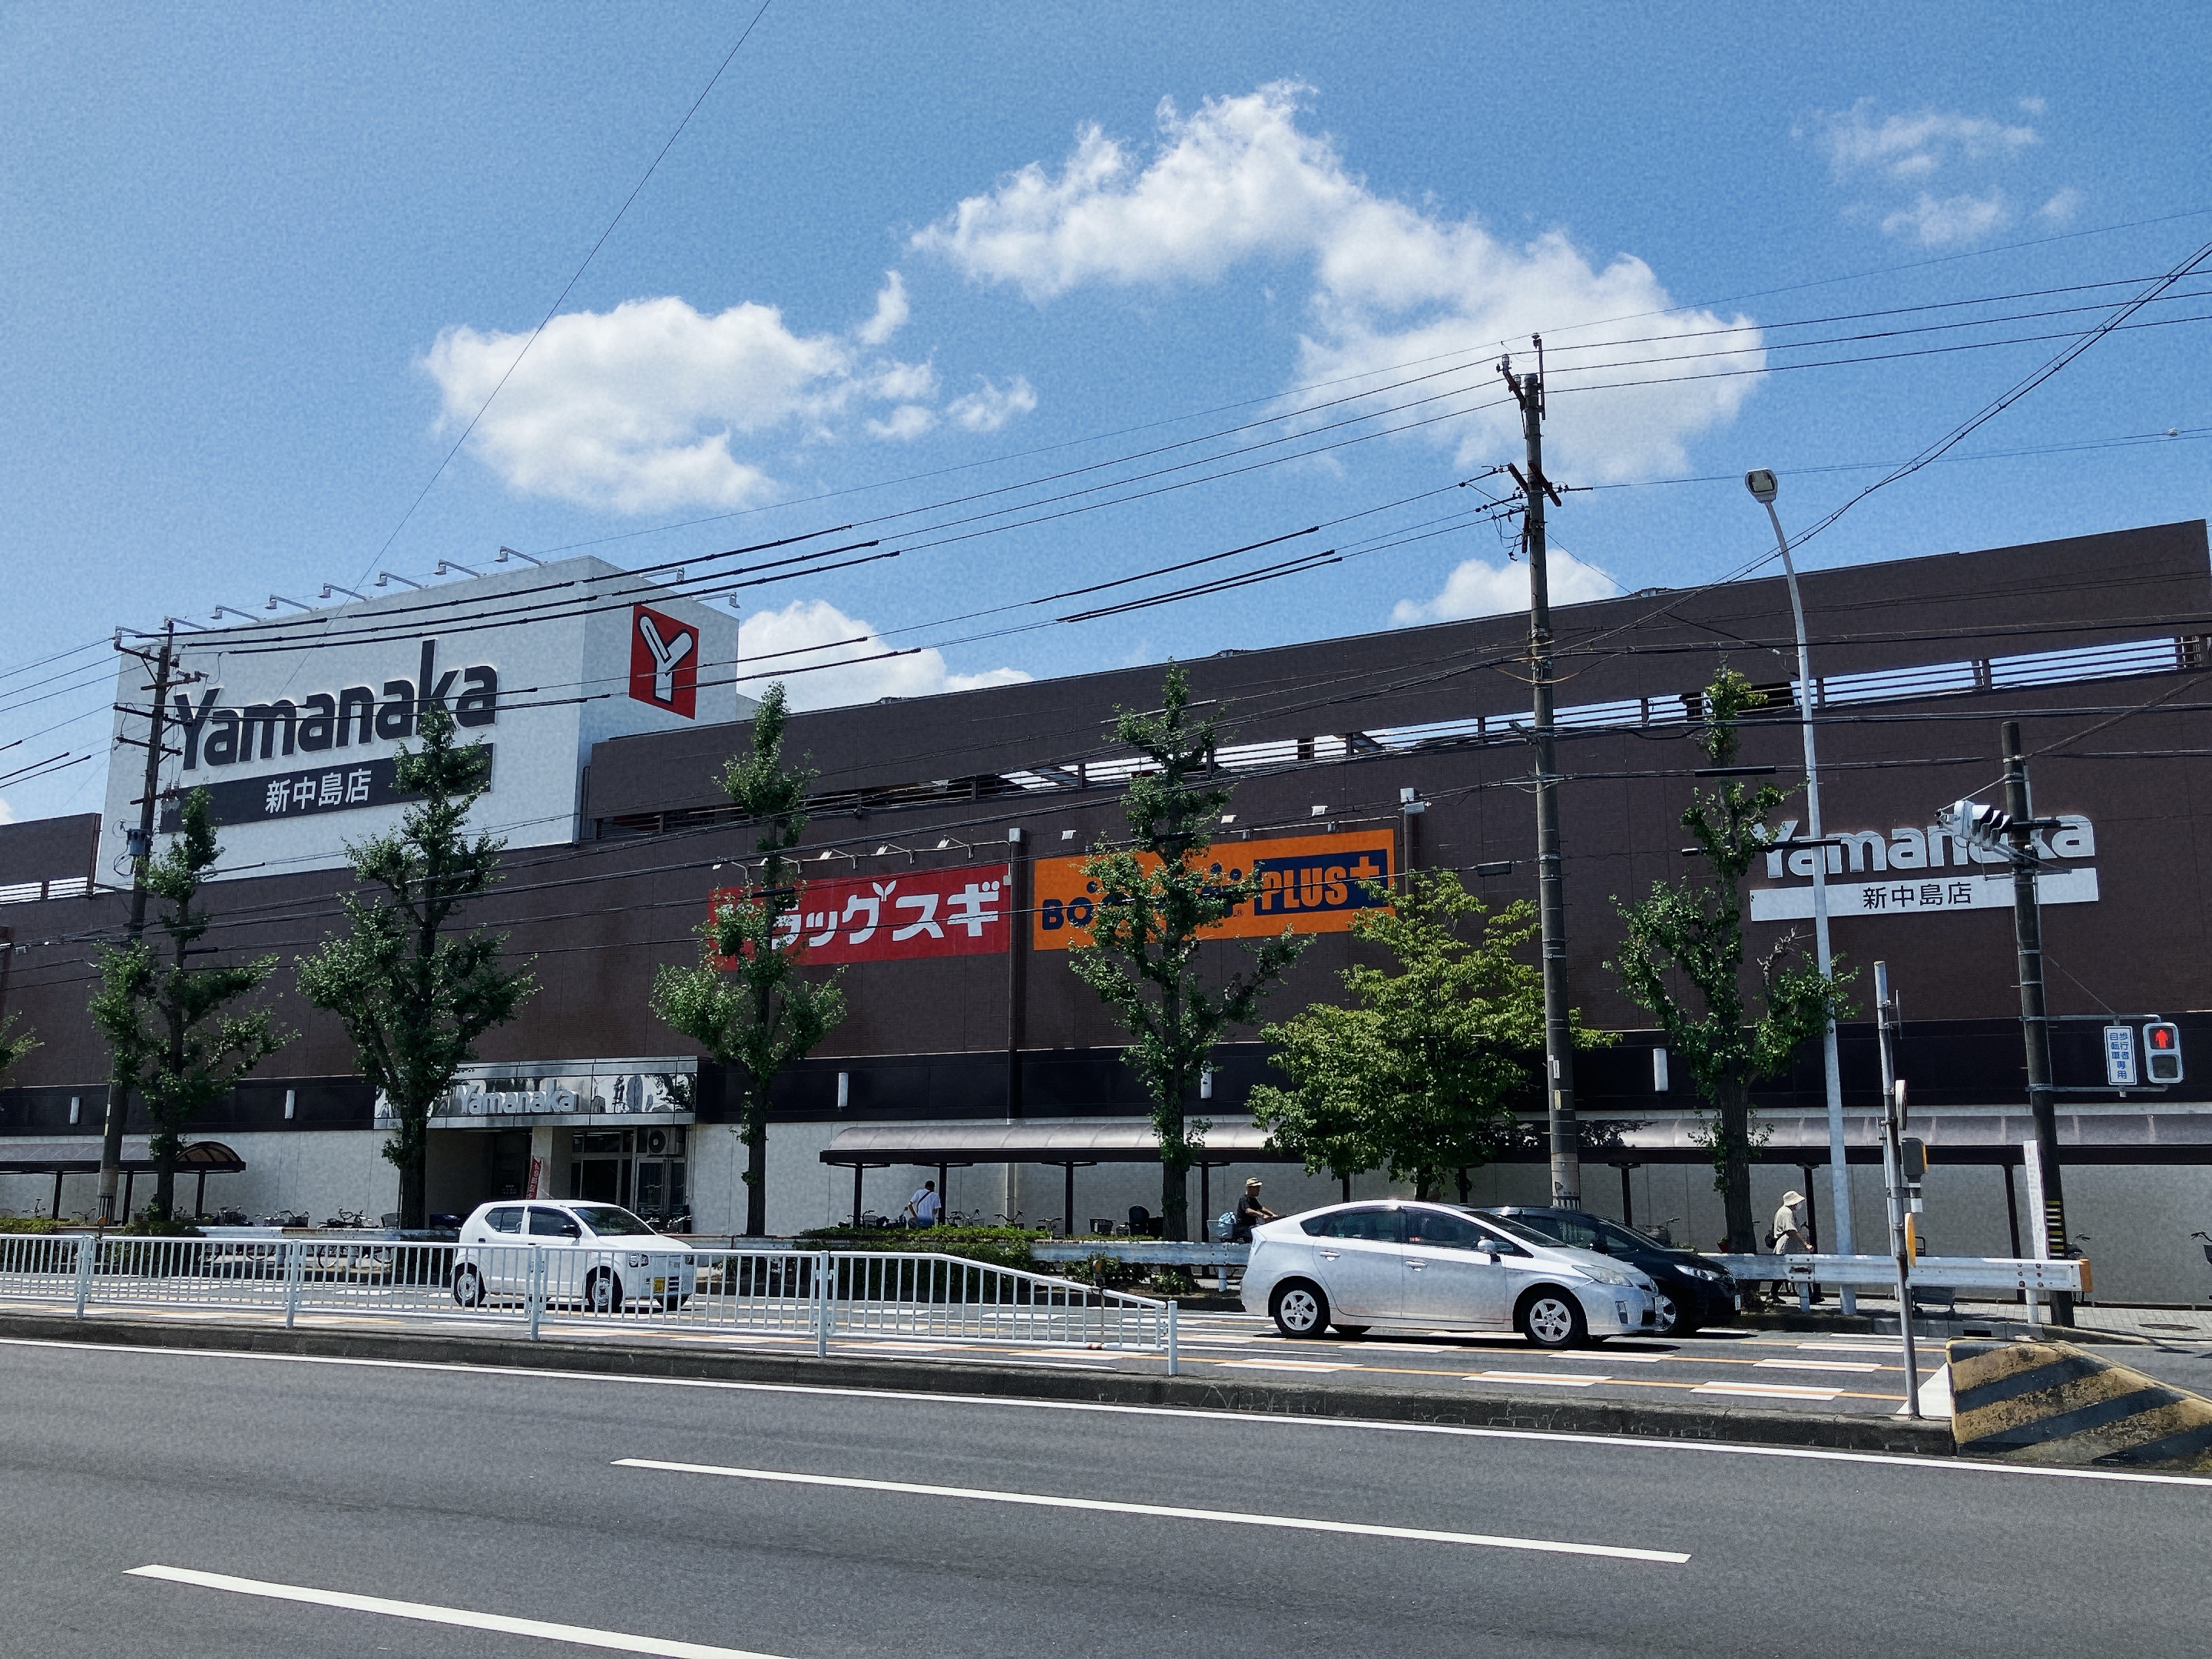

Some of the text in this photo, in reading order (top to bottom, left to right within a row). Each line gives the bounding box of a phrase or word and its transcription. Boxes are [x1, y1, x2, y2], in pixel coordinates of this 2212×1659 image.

[174, 639, 498, 770] Yamanaka
[265, 769, 370, 813] 新中島店
[1863, 882, 1972, 909] 新中島店
[455, 1078, 577, 1114] Yamanaka
